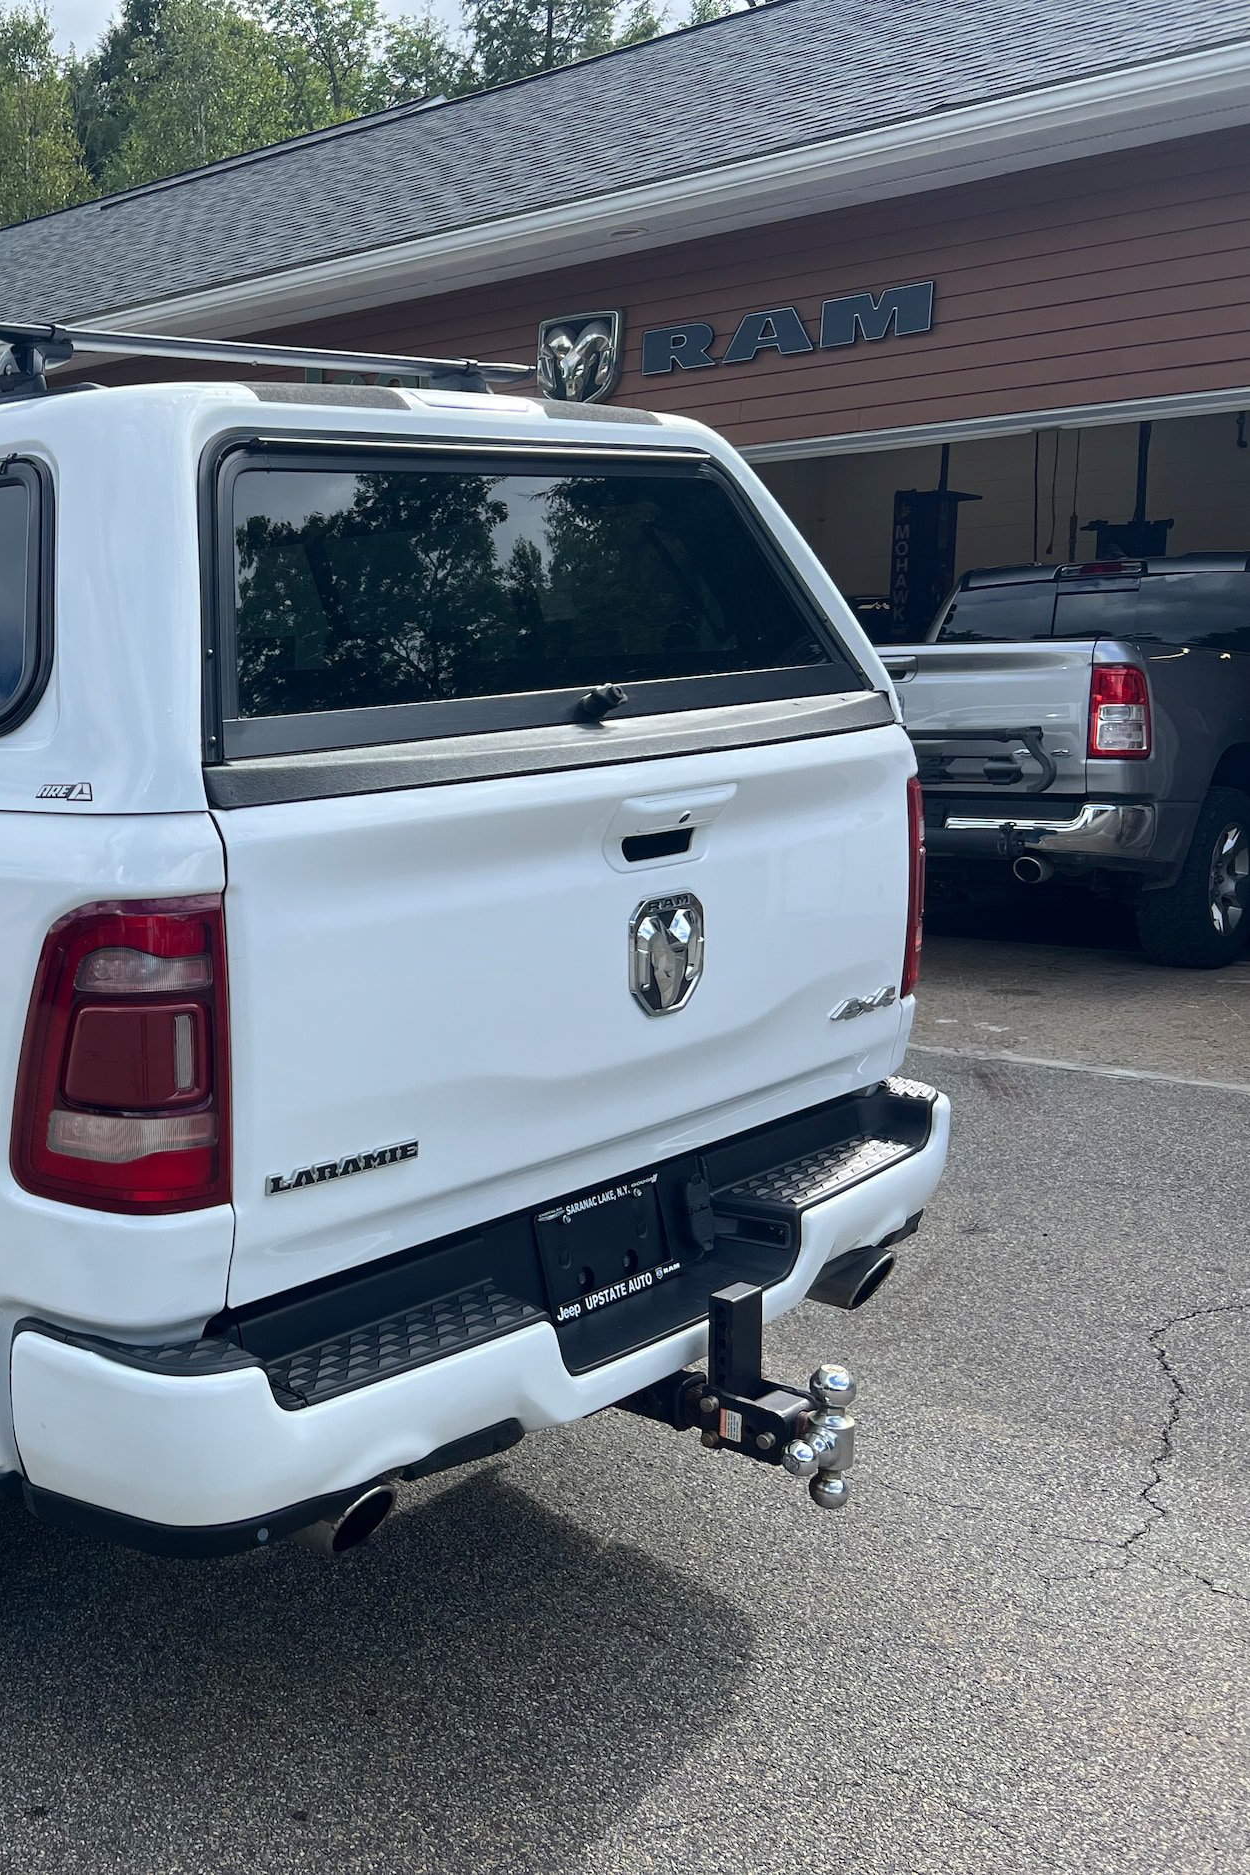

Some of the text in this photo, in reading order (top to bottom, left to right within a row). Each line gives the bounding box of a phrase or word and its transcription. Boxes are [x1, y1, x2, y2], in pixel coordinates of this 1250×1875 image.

[641, 280, 934, 376] RAM
[893, 524, 911, 622] MOHAWK
[649, 894, 690, 912] RAM
[265, 1137, 419, 1196] LARAMIE
[565, 1195, 598, 1216] SARANAC
[597, 1189, 617, 1204] LAKE,
[616, 1185, 631, 1198] N.Y.
[556, 1262, 681, 1321] Jeep UPSTATE AUTO RAM
